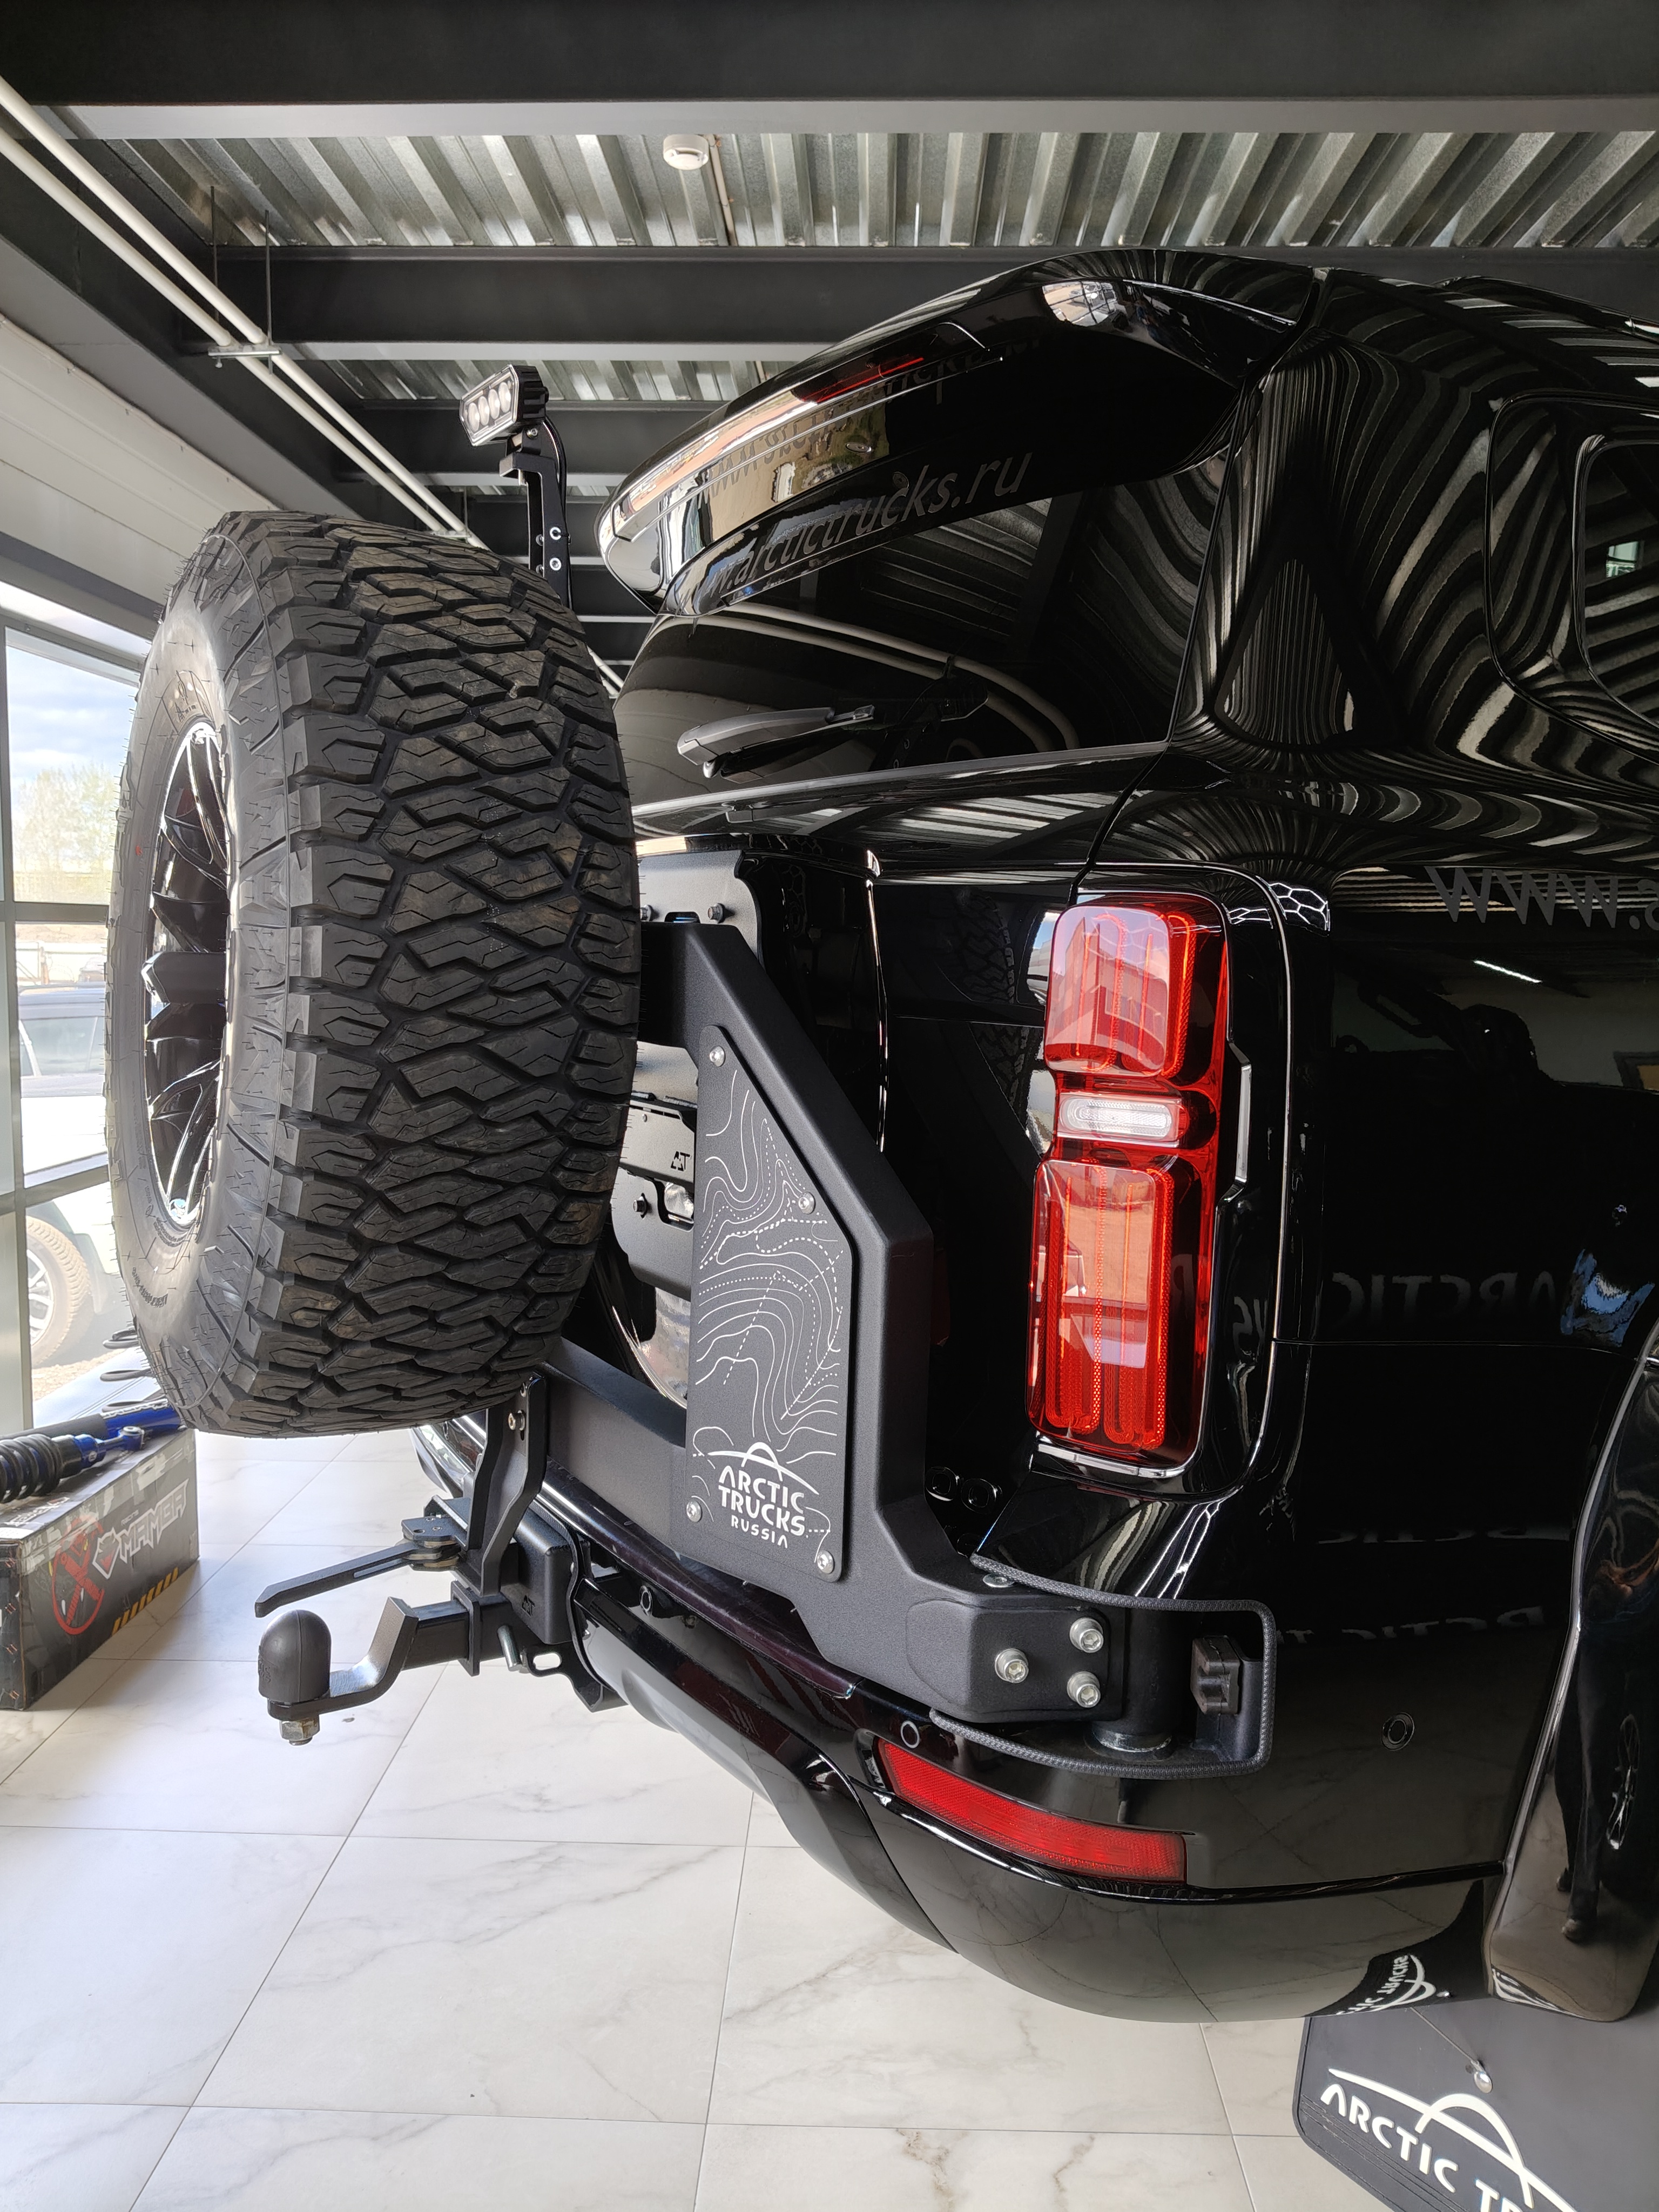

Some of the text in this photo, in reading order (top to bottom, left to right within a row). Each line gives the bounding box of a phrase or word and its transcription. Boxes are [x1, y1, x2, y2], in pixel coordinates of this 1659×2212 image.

[718, 1465, 805, 1514] ARCTIC
[718, 1485, 805, 1536] TRUCKS
[731, 1514, 788, 1549] RUSSIA
[1320, 2083, 1458, 2193] ARCTIC
